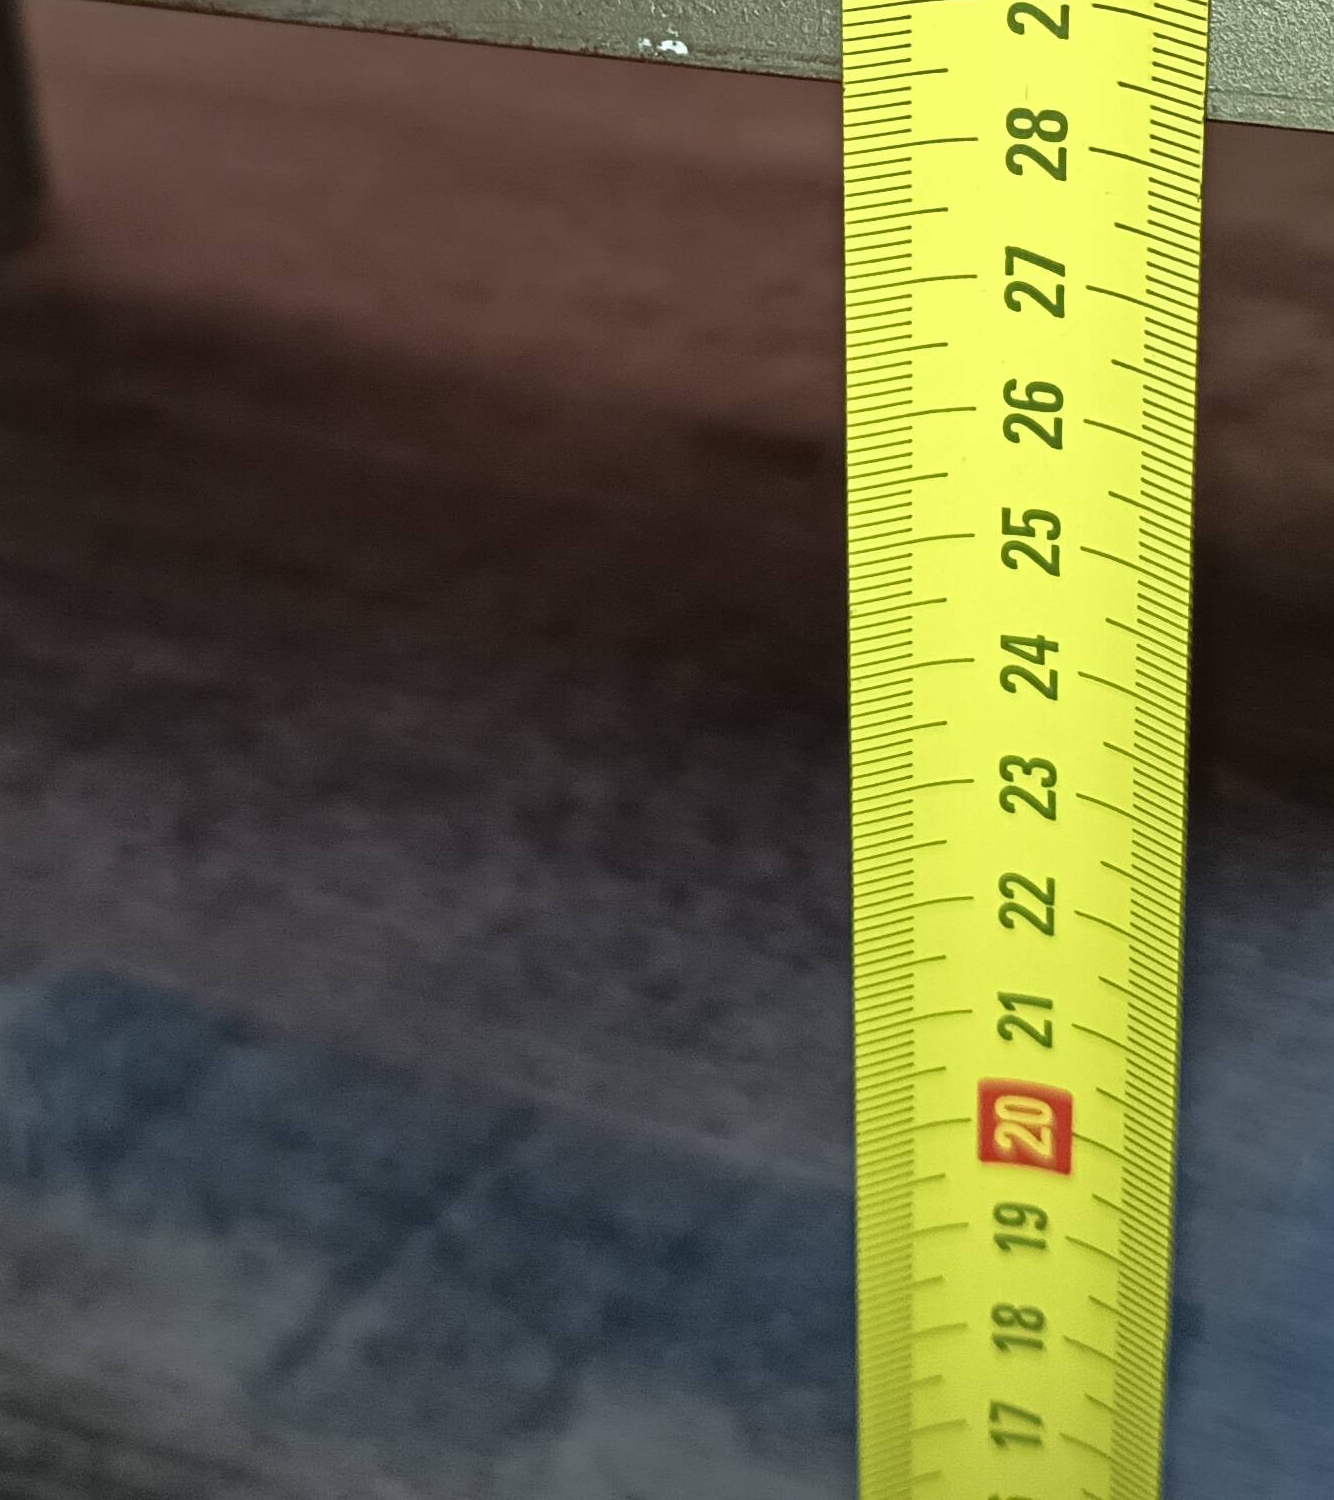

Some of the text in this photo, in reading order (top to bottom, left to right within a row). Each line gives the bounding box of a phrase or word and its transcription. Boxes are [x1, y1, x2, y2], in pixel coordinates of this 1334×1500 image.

[1005, 107, 1069, 182] 28
[1003, 245, 1066, 319] 27
[1002, 378, 1064, 451] 26
[1001, 506, 1062, 578] 25
[1000, 634, 1060, 702] 24
[998, 754, 1058, 822] 23
[998, 872, 1056, 938] 22
[996, 991, 1054, 1050] 21
[993, 1094, 1057, 1159] 20
[992, 1202, 1049, 1253] 19
[990, 1304, 1047, 1353] 18
[988, 1401, 1043, 1449] 17
